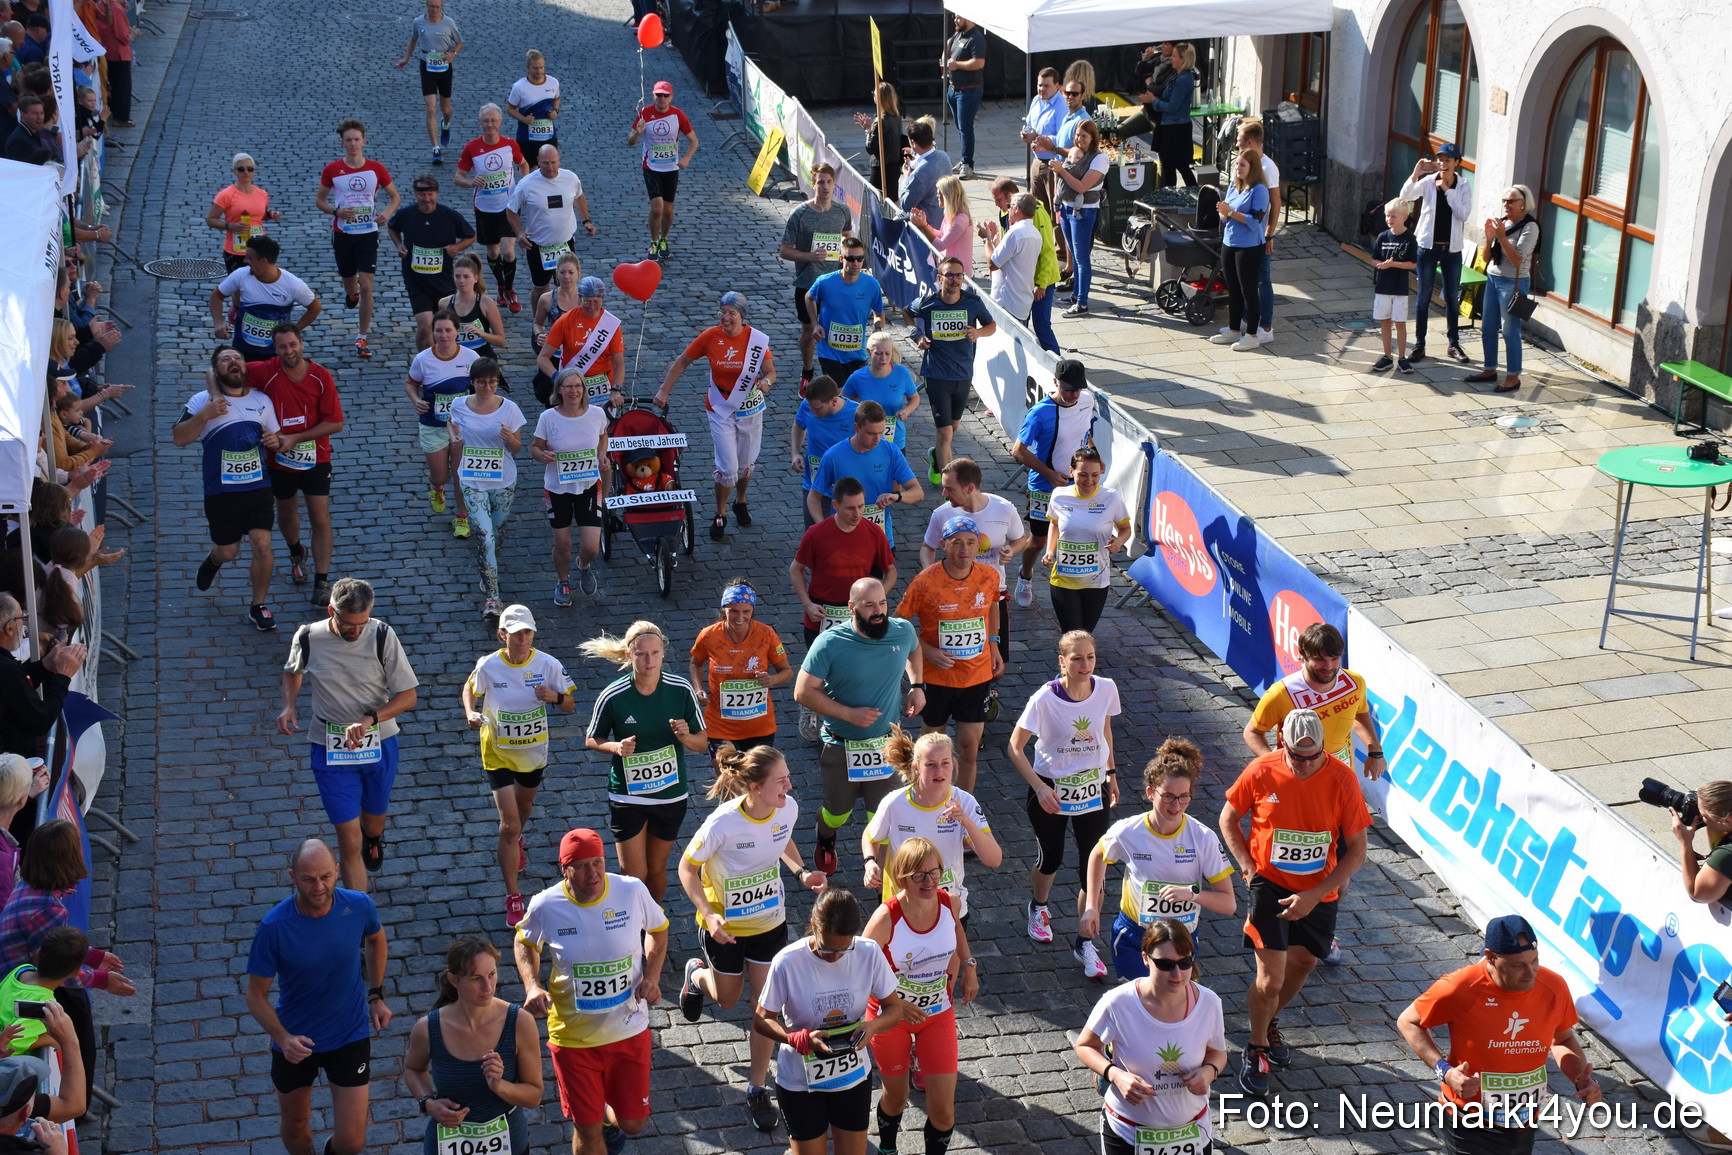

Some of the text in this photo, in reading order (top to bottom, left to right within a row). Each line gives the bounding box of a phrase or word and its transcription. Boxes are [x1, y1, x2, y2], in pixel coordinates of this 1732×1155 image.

[531, 126, 551, 134] 2083
[654, 150, 674, 159] 2453
[484, 179, 508, 190] 2452
[416, 256, 439, 266] 1123
[244, 324, 272, 338] 2669
[936, 321, 963, 331] 1080
[833, 334, 859, 343] 1033
[575, 352, 592, 370] wir
[590, 328, 609, 354] auch
[738, 345, 763, 393] wir auch
[586, 376, 606, 385] OCK
[587, 384, 608, 397] 613
[739, 394, 762, 411] 2069
[609, 436, 685, 450] den besten Jahren
[226, 450, 256, 460] BOCK
[468, 448, 498, 456] BOCK
[559, 450, 593, 460] BOCK
[226, 460, 256, 474] 2668
[467, 458, 499, 470] 2276
[562, 459, 594, 473] 2277
[562, 471, 596, 481] KATHARINA
[608, 490, 693, 508] 20.Stadtlauf
[1154, 497, 1214, 581] Hervis
[1060, 542, 1096, 552] BOCK
[1061, 552, 1096, 566] 2258
[1061, 566, 1094, 575] KIM-LARA
[1230, 577, 1252, 607] ONLINE
[826, 608, 851, 618] BOC
[943, 621, 980, 632] BOCK
[1229, 604, 1252, 636] MOBILE
[944, 632, 981, 648] 2273
[724, 680, 763, 690] BOCK
[726, 691, 763, 707] 2272
[501, 708, 542, 722] BOCK
[731, 706, 759, 717] BIANKA
[1317, 695, 1360, 722] AX BÖGL
[503, 720, 542, 737] 1125
[508, 737, 538, 746] GISELA
[332, 751, 376, 761] REINHARD
[1056, 746, 1081, 755] GESUND
[1081, 745, 1095, 753] UND
[626, 749, 671, 766] BOCK
[631, 761, 673, 781] 2030
[862, 769, 885, 778] KARL
[642, 779, 667, 791] JULIA
[1060, 783, 1097, 802] 2420
[1069, 802, 1090, 812] ANJA
[1279, 832, 1327, 843] BOCK
[1278, 846, 1323, 861] 2830
[729, 870, 775, 888] BOCK
[731, 883, 774, 906] 2044
[741, 903, 766, 915] LINDA
[1147, 898, 1194, 914] 2060
[603, 910, 615, 921] 20
[604, 915, 631, 926] Neumarkter
[605, 922, 627, 932] Stadtlauf
[912, 952, 948, 968] Physiotherapie
[578, 961, 629, 977] BOCK
[907, 970, 943, 980] machen Sie
[581, 974, 629, 997] 2813
[897, 978, 946, 994] BOCK
[1488, 1039, 1540, 1050] funrunners
[1504, 1046, 1547, 1056] neumarkt
[813, 1051, 859, 1081] 2759
[1490, 1073, 1541, 1087] BOCK
[443, 1119, 502, 1137] BOCK
[1142, 1127, 1194, 1142] BOCK
[447, 1136, 502, 1155] 1049
